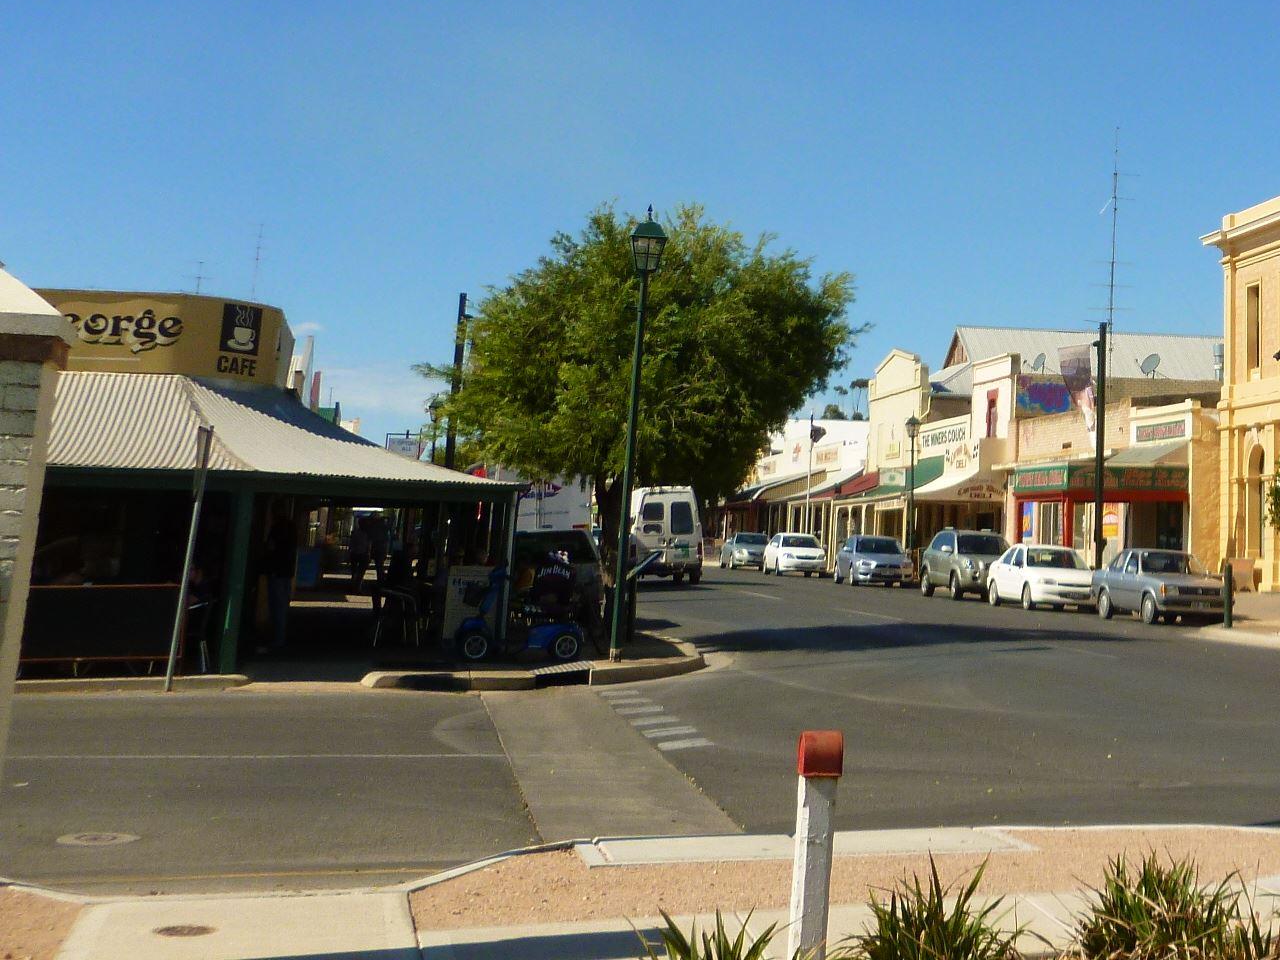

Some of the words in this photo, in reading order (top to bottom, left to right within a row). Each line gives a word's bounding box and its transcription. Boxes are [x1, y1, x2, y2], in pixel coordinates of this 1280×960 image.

[217, 355, 257, 377] CAFE
[922, 435, 930, 448] THE
[930, 430, 947, 446] MINERS
